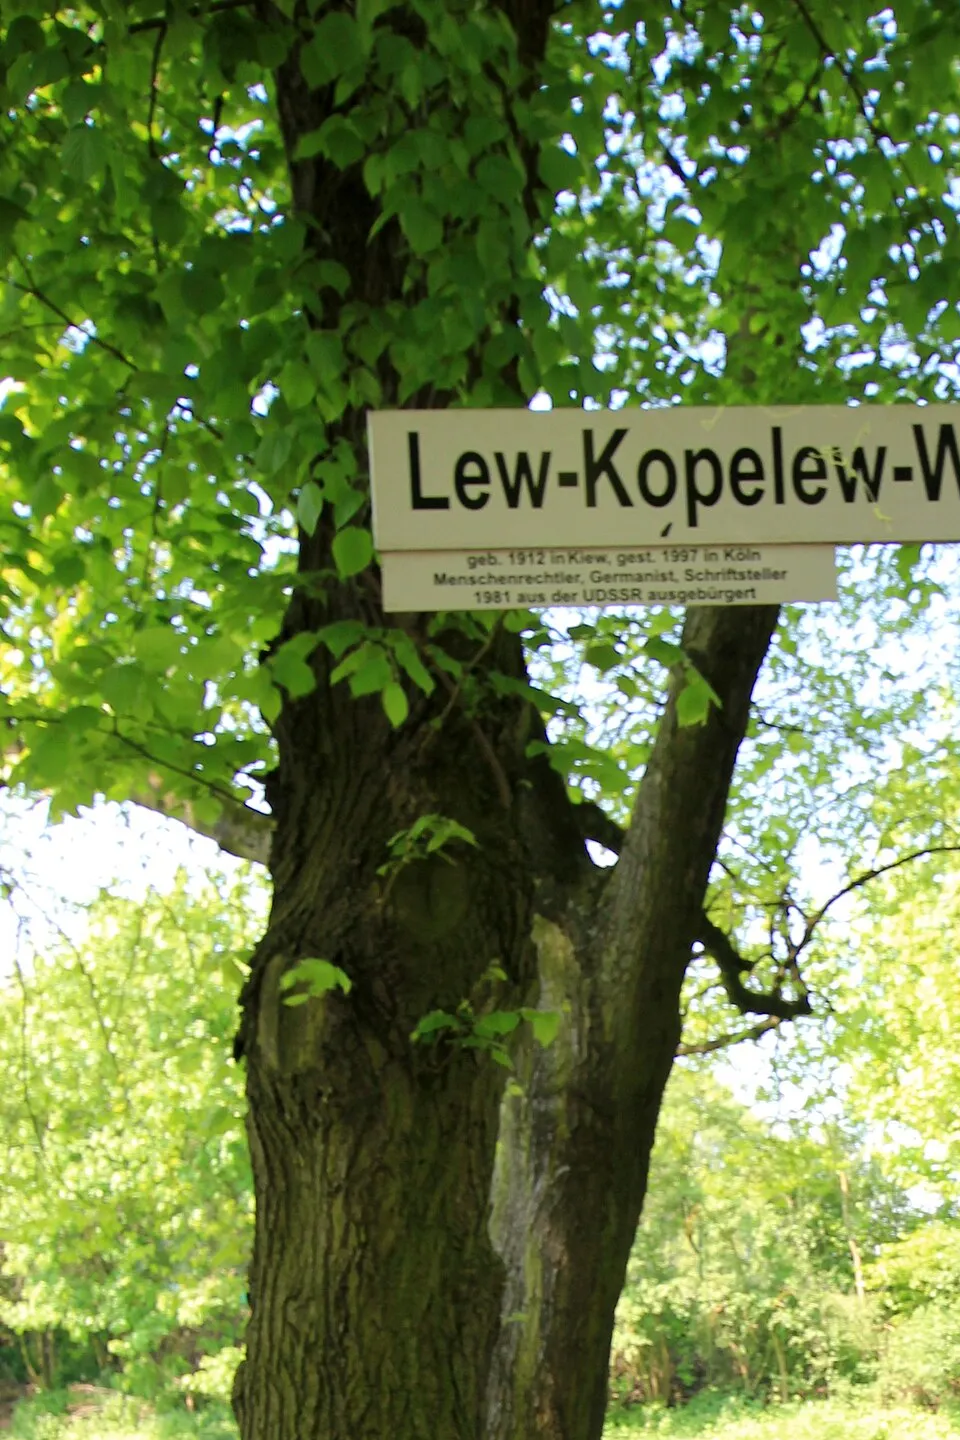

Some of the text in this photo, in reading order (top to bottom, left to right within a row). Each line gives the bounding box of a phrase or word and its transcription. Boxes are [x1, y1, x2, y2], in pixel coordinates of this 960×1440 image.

[467, 546, 762, 569] geb. 1912 in Kiew, gest. 1997 in Köln
[433, 564, 788, 587] Menschenrechtler, Germanist, Schriftsteller
[473, 584, 757, 604] 1981 aus der UDSSR ausgebürgert
